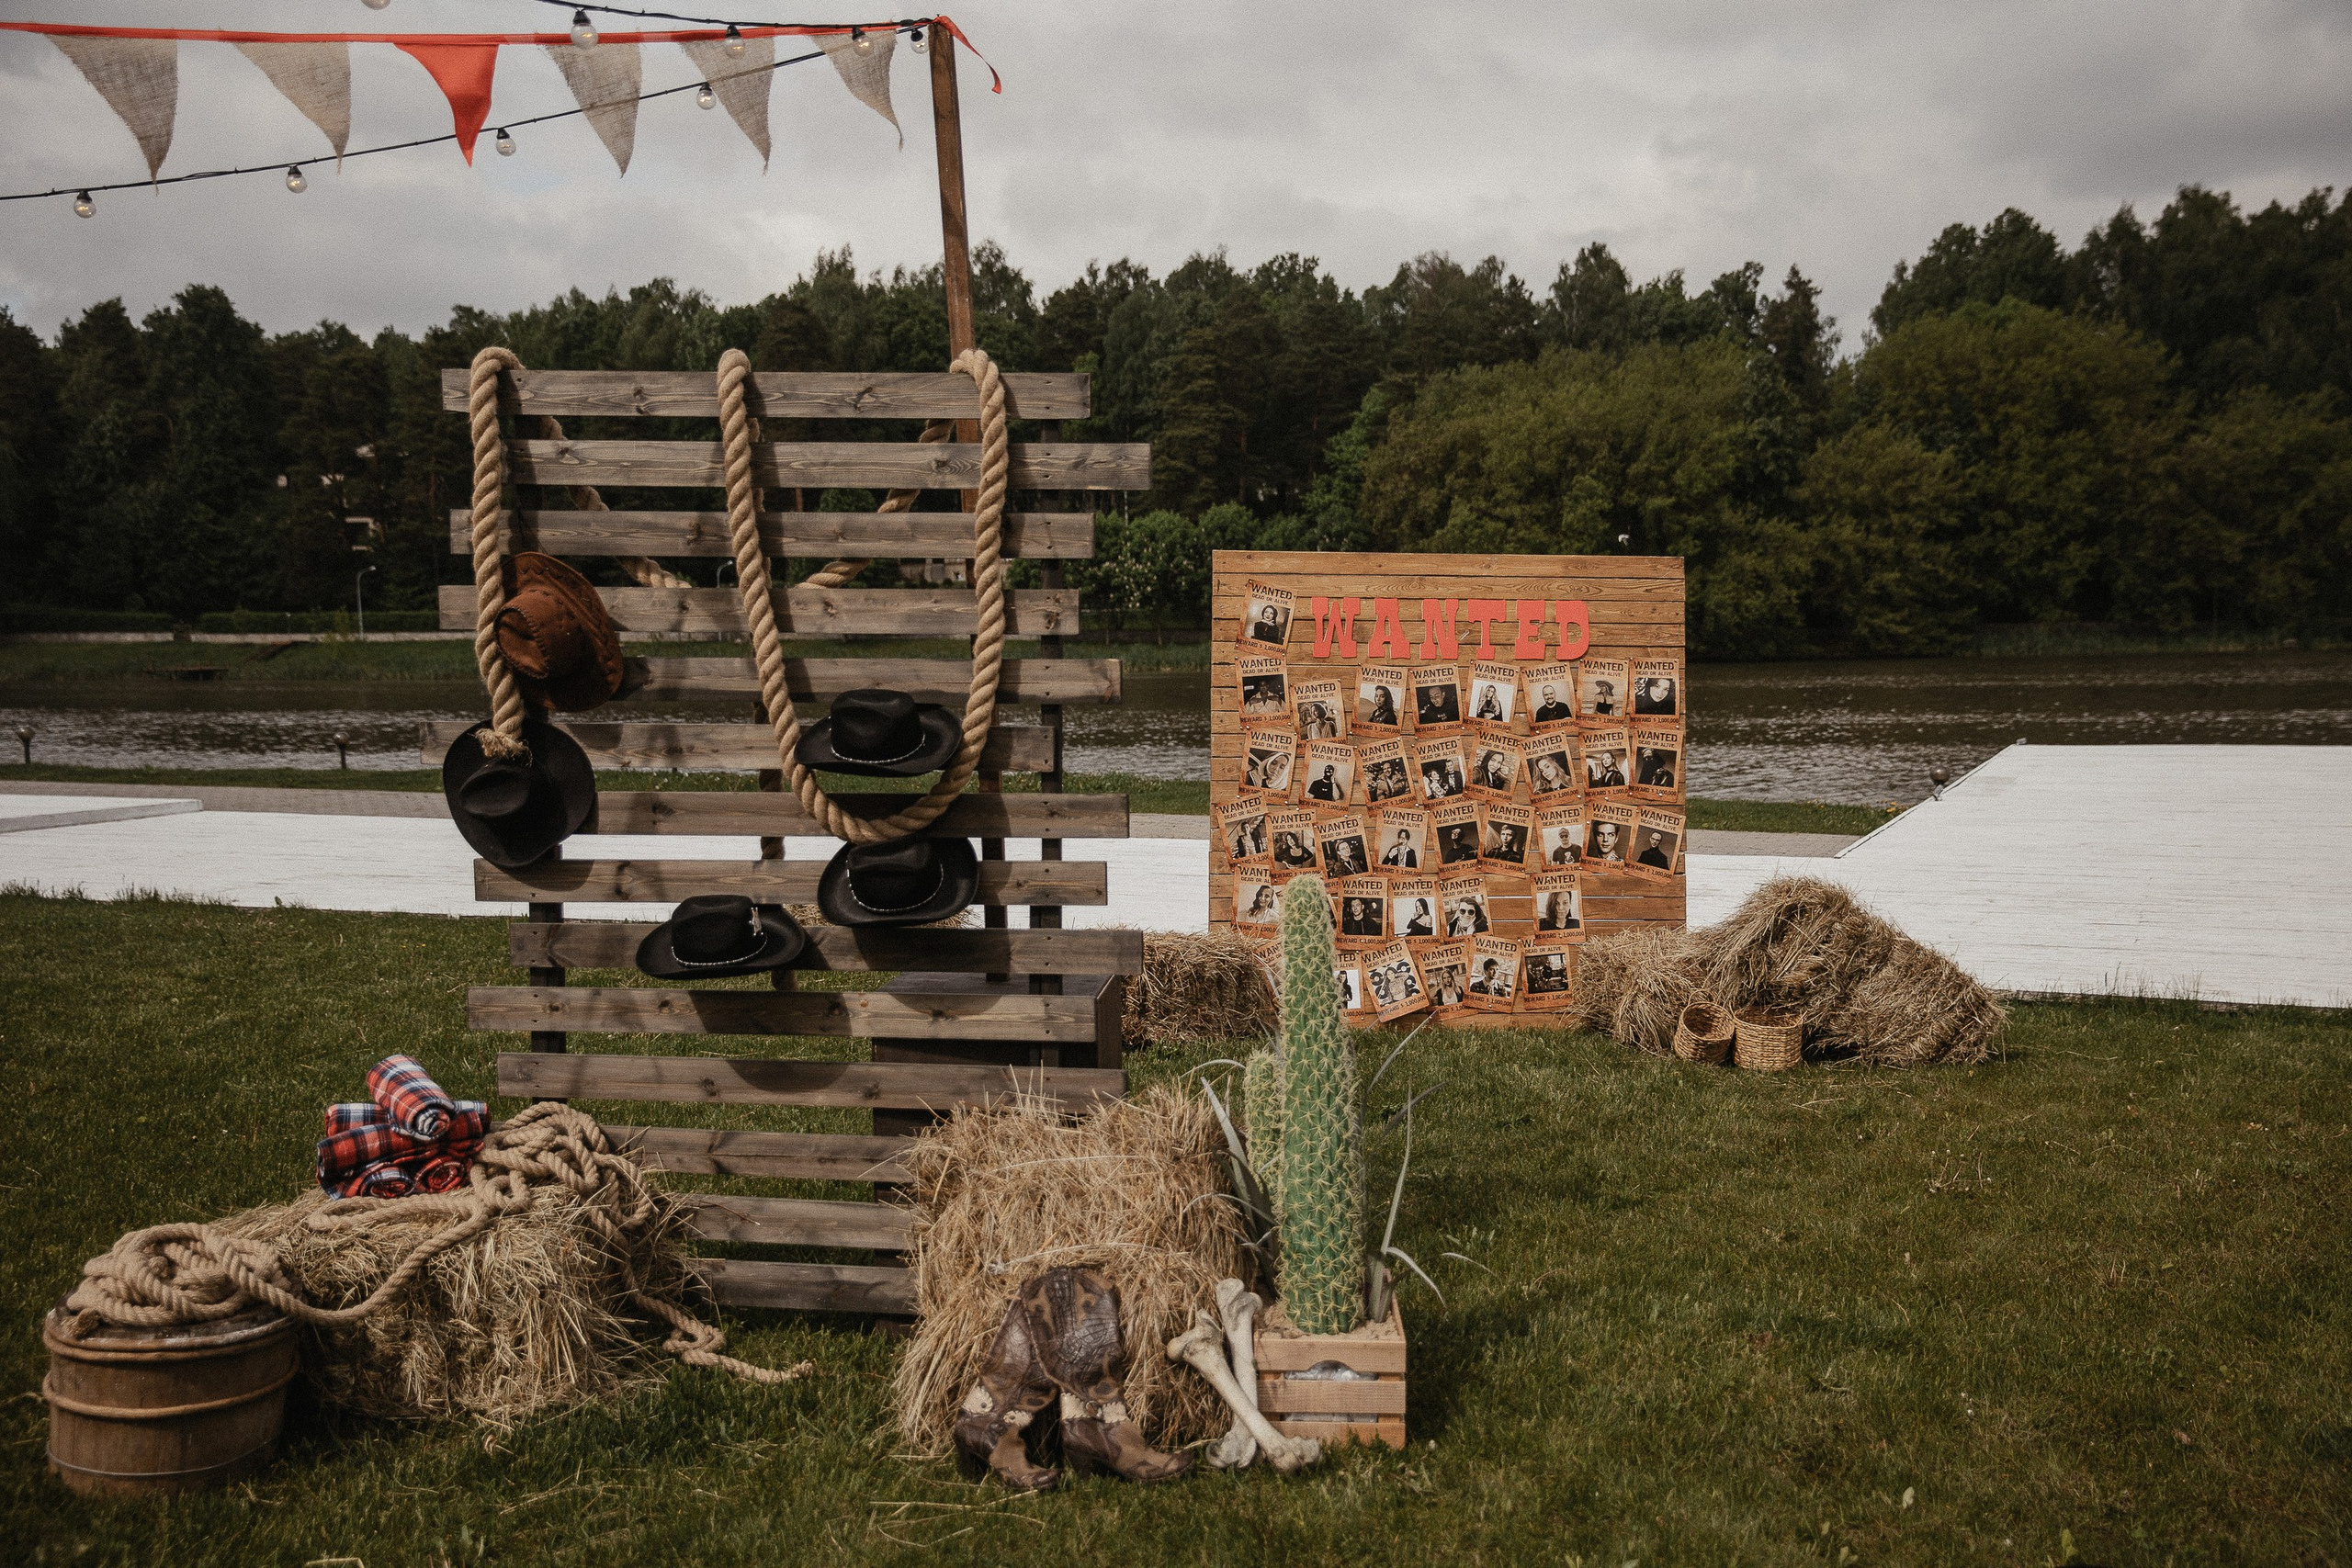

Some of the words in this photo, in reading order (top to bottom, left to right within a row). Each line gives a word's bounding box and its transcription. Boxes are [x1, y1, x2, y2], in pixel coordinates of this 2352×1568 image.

[1252, 583, 1293, 600] WANTED
[1311, 597, 1590, 660] WANTED
[1239, 658, 1282, 669] WANTED
[1475, 663, 1515, 677] WANTED
[1584, 660, 1623, 671] WANTED
[1634, 661, 1674, 671] WANTED
[1362, 667, 1403, 680] WANTED
[1412, 668, 1453, 679] WANTED
[1525, 665, 1566, 678] WANTED
[1295, 682, 1336, 694] WANTED
[1251, 731, 1293, 745] WANTED
[1583, 732, 1623, 743] WANTED
[1637, 730, 1678, 742] WANTED
[1358, 741, 1399, 758] WANTED
[1416, 740, 1457, 755] WANTED
[1521, 735, 1562, 751] WANTED
[1311, 743, 1351, 758] WANTED
[1219, 797, 1261, 815] WANTED
[1246, 807, 1261, 815] ALIVE
[1432, 805, 1474, 819] WANTED
[1490, 804, 1530, 818] WANTED
[1593, 803, 1633, 818] WANTED
[1270, 813, 1311, 824] WANTED
[1383, 809, 1423, 822] WANTED
[1540, 809, 1580, 821] WANTED
[1641, 808, 1680, 826] WANTED
[1317, 818, 1359, 834] WANTED
[1240, 866, 1269, 876] WANT
[1342, 880, 1383, 890] WANTED
[1391, 881, 1432, 890] WANTED
[1439, 878, 1481, 891] WANTED
[1534, 874, 1576, 886] WANTED
[1476, 938, 1517, 953] WANTED
[1420, 946, 1462, 962] WANTED
